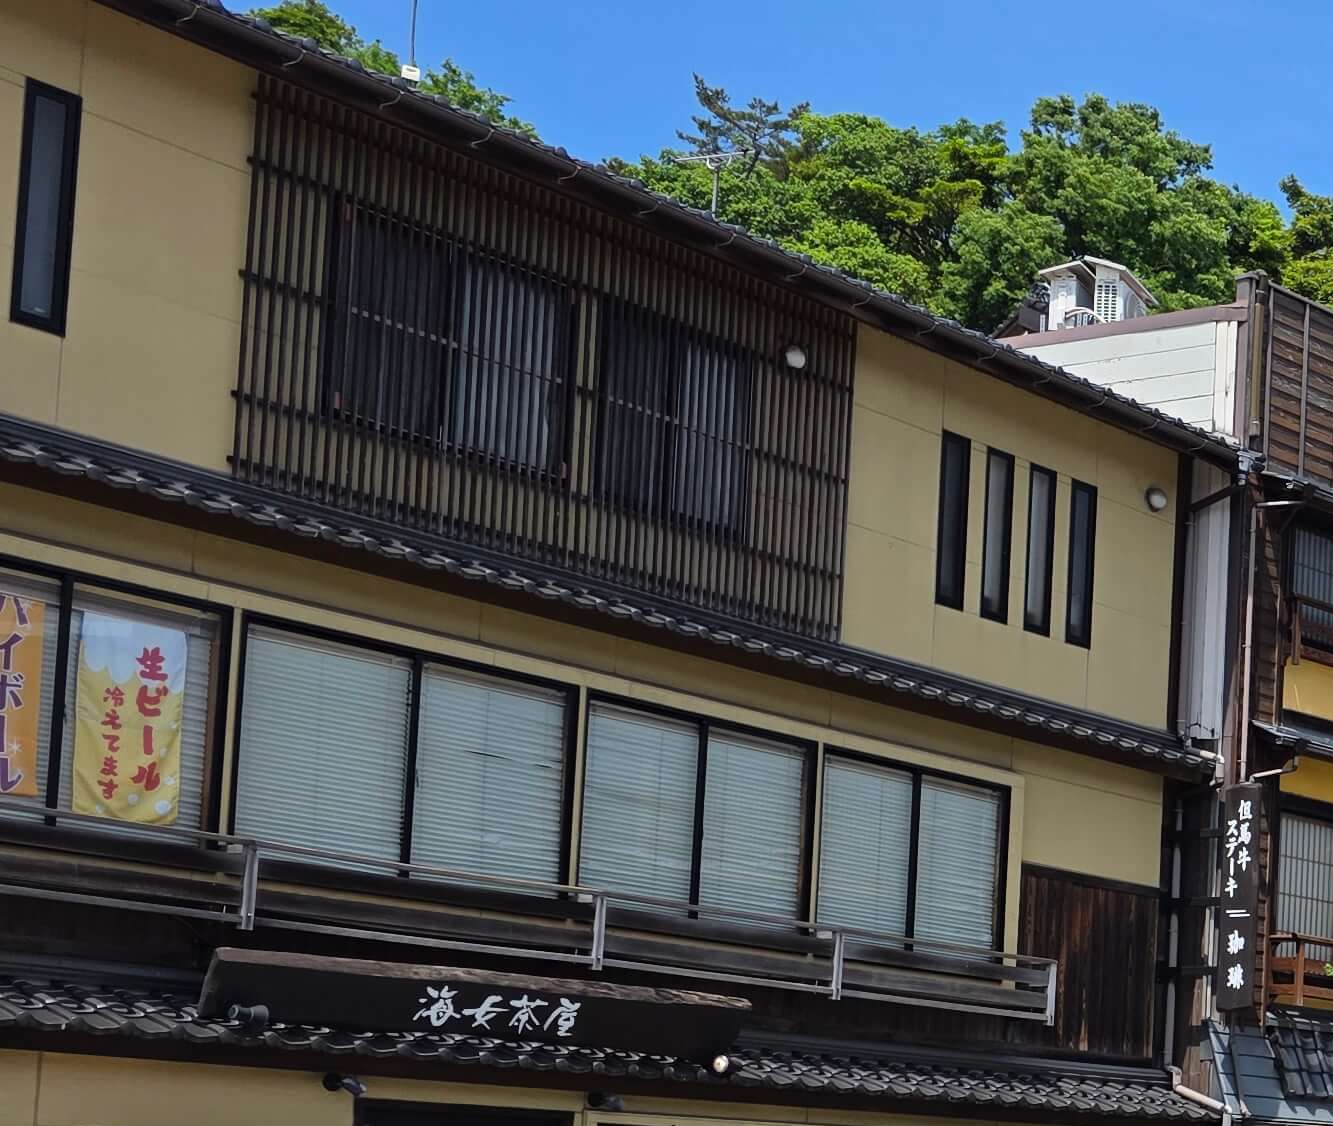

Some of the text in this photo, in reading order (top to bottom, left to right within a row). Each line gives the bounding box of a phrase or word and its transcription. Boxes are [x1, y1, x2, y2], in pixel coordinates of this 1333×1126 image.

[97, 686, 125, 800] 冷えてます
[132, 646, 168, 792] 生ビール
[1224, 819, 1239, 898] ステーキ
[1237, 799, 1252, 871] 但馬牛
[1226, 929, 1246, 990] 珈琲
[412, 985, 582, 1037] 海女茶屋
